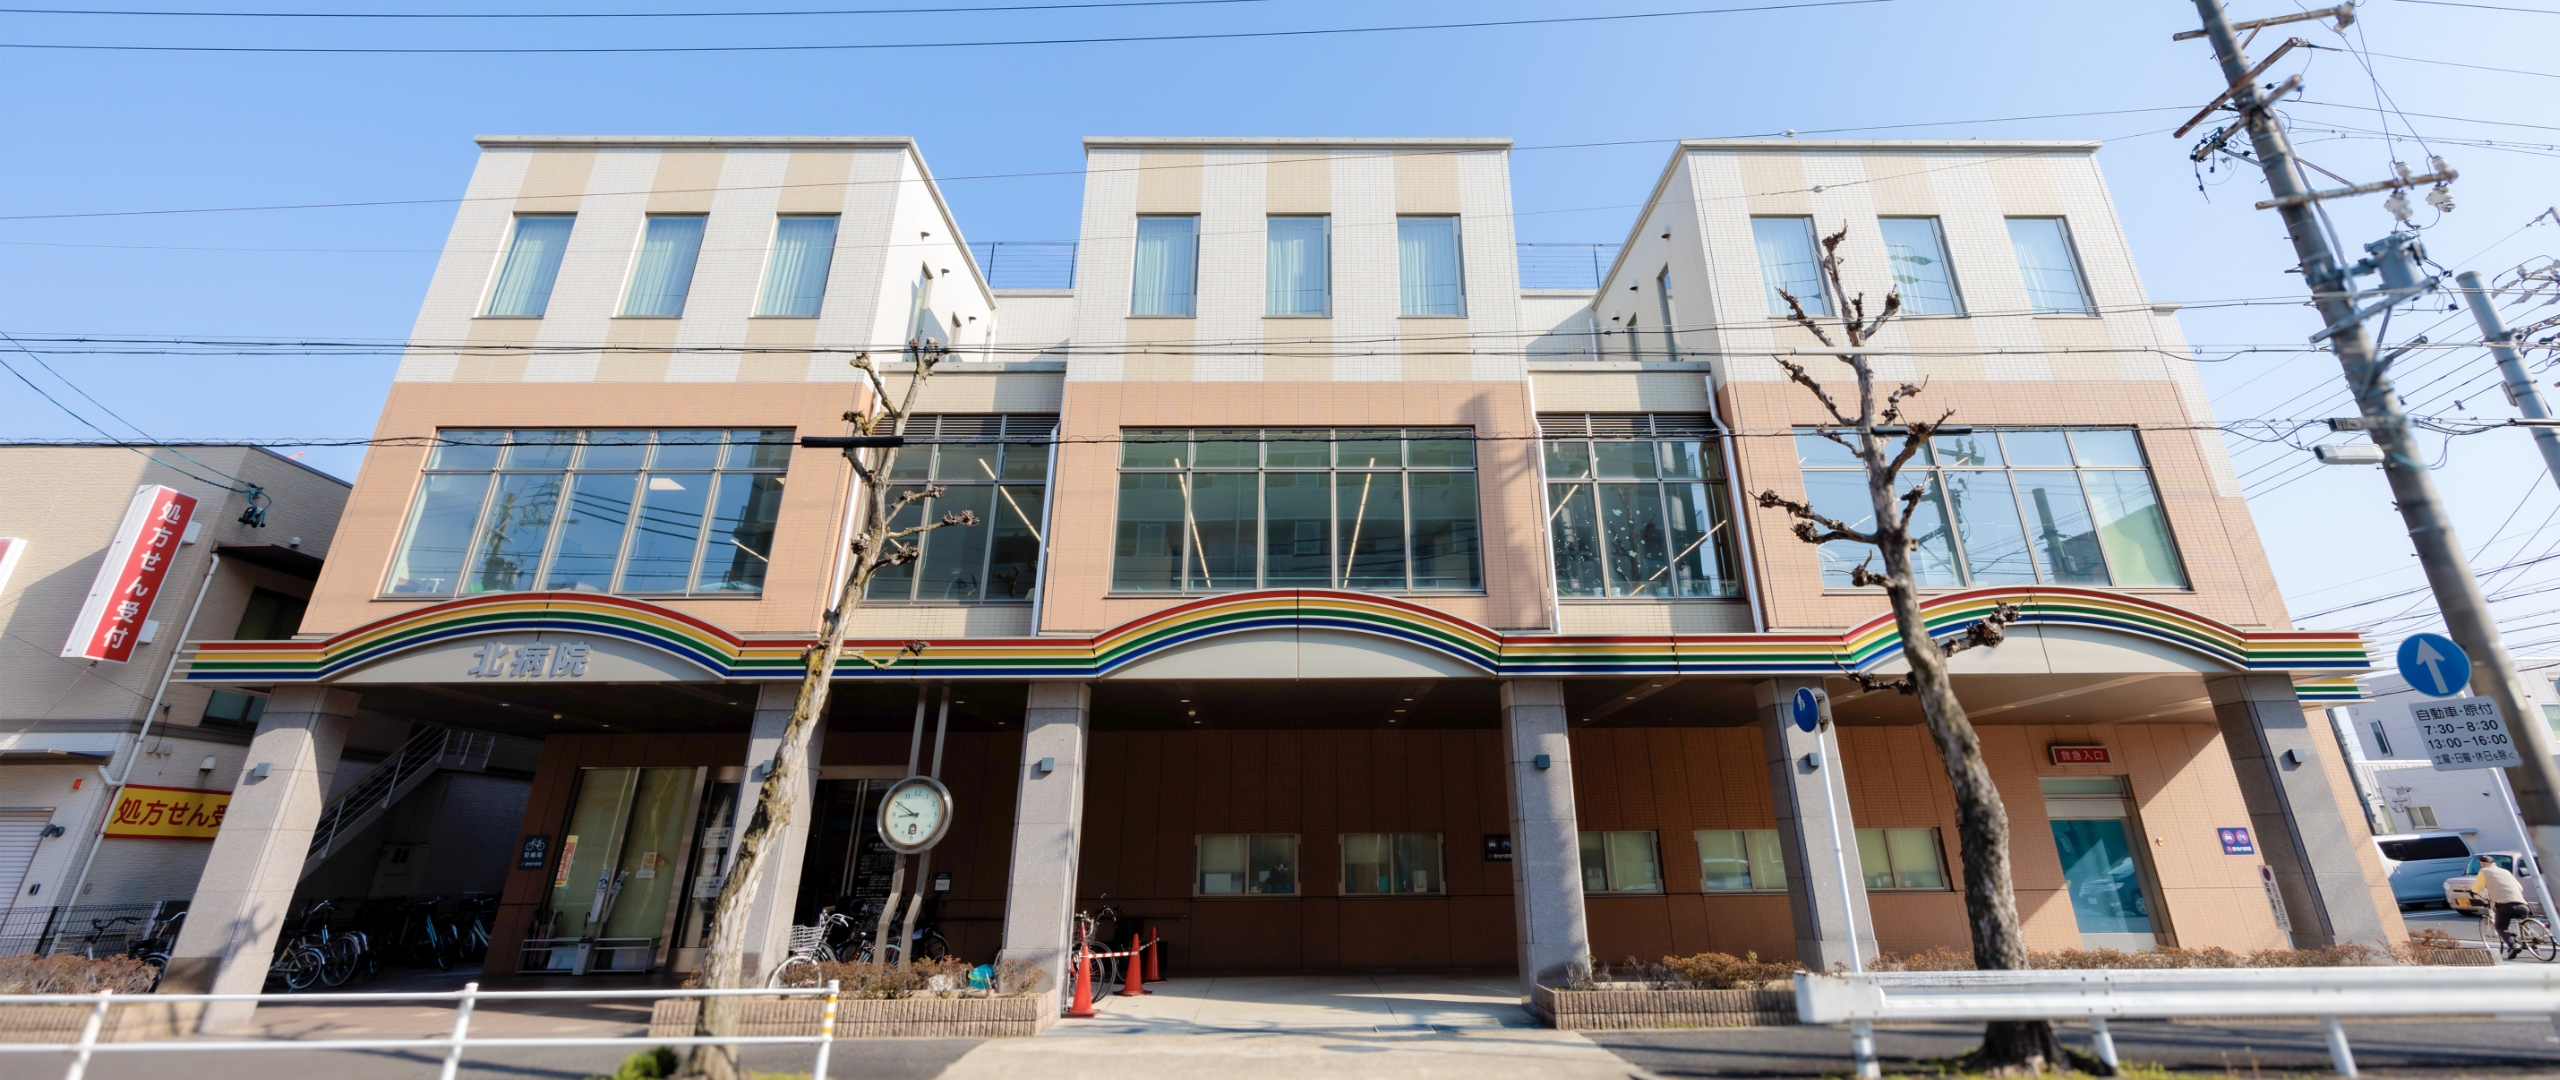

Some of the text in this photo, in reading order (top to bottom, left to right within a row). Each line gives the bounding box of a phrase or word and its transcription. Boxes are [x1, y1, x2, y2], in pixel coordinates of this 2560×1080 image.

[103, 500, 182, 649] 処方せん受付
[468, 641, 592, 677] 北病院
[2416, 703, 2493, 721] 自動車・原付
[2060, 750, 2104, 761] 救急入口
